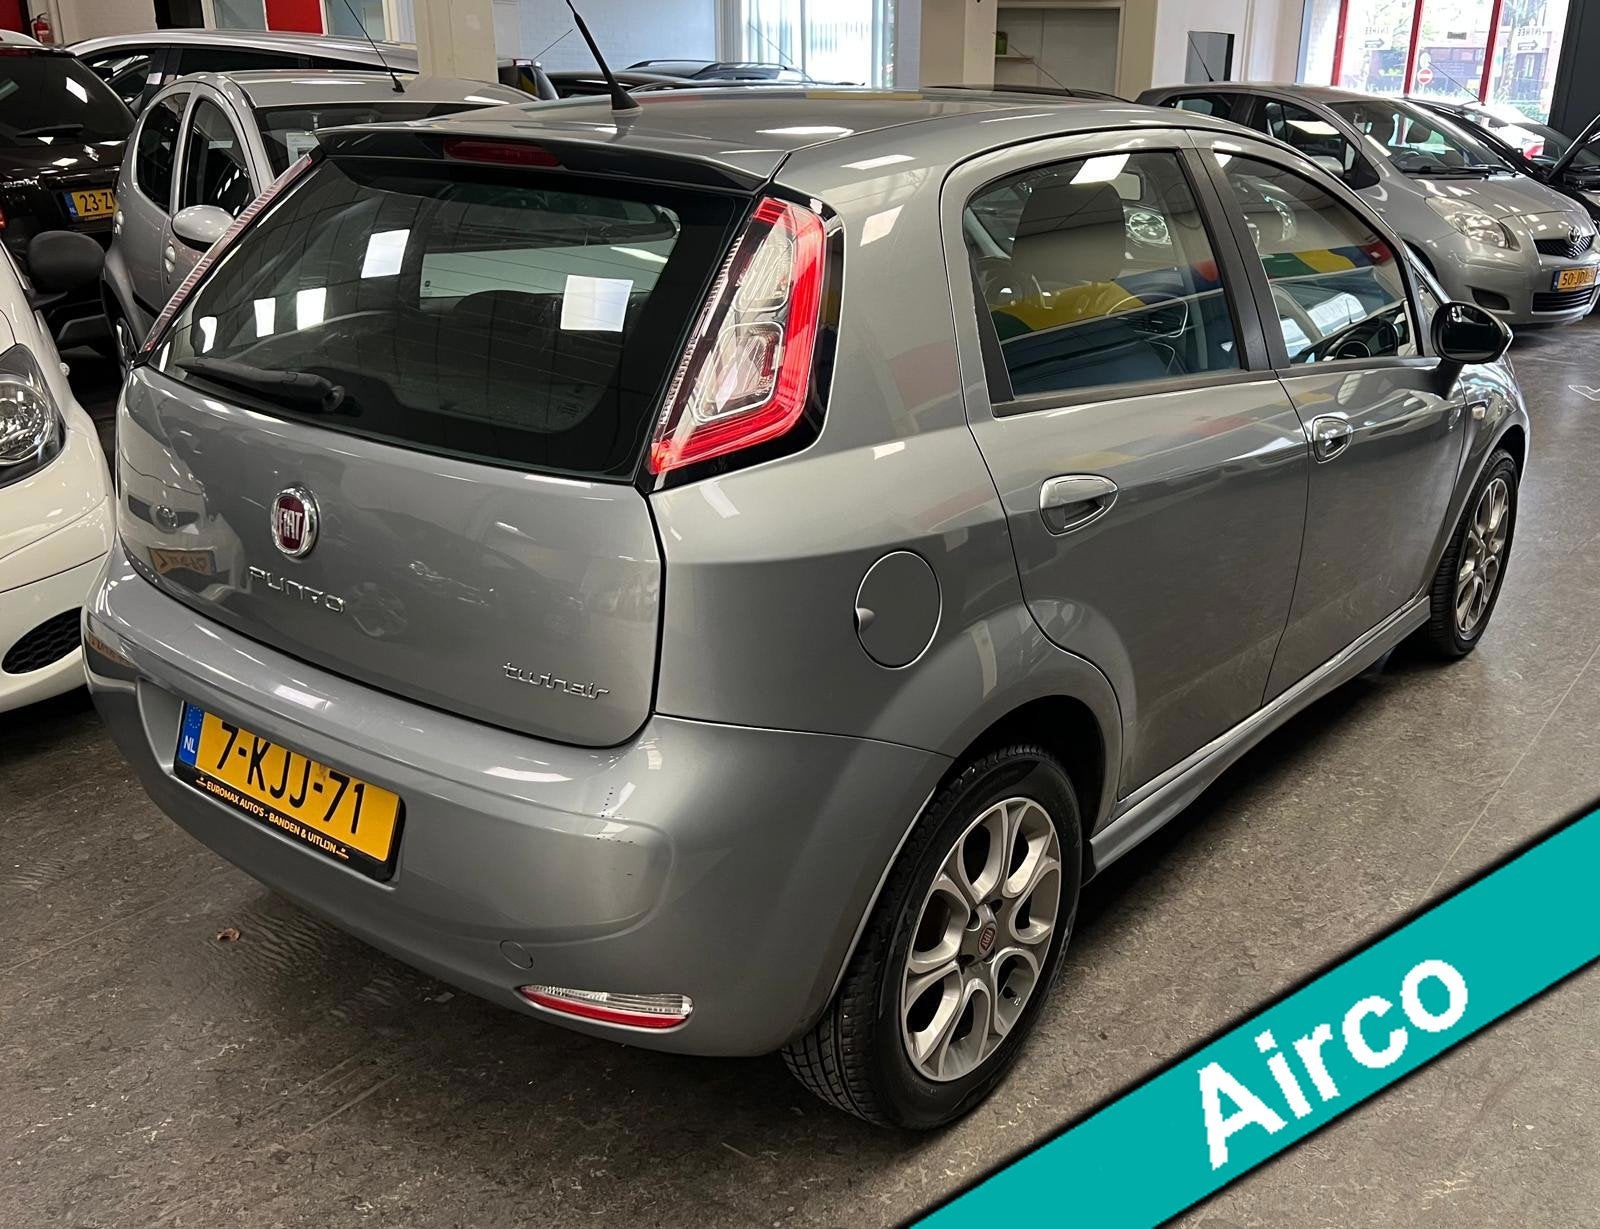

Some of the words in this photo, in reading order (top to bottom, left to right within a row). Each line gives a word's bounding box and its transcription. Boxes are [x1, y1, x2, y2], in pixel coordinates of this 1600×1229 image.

[279, 507, 303, 541] FIAT
[249, 565, 345, 613] PUNTO
[502, 661, 609, 700] twinair
[183, 735, 196, 754] NL
[216, 721, 365, 835] 7-KJJ-71
[206, 781, 240, 804] EUROMAX
[239, 798, 265, 817] AUTO'S
[269, 812, 301, 836] BANDEN
[301, 828, 307, 839] &
[981, 928, 994, 949] FIAT
